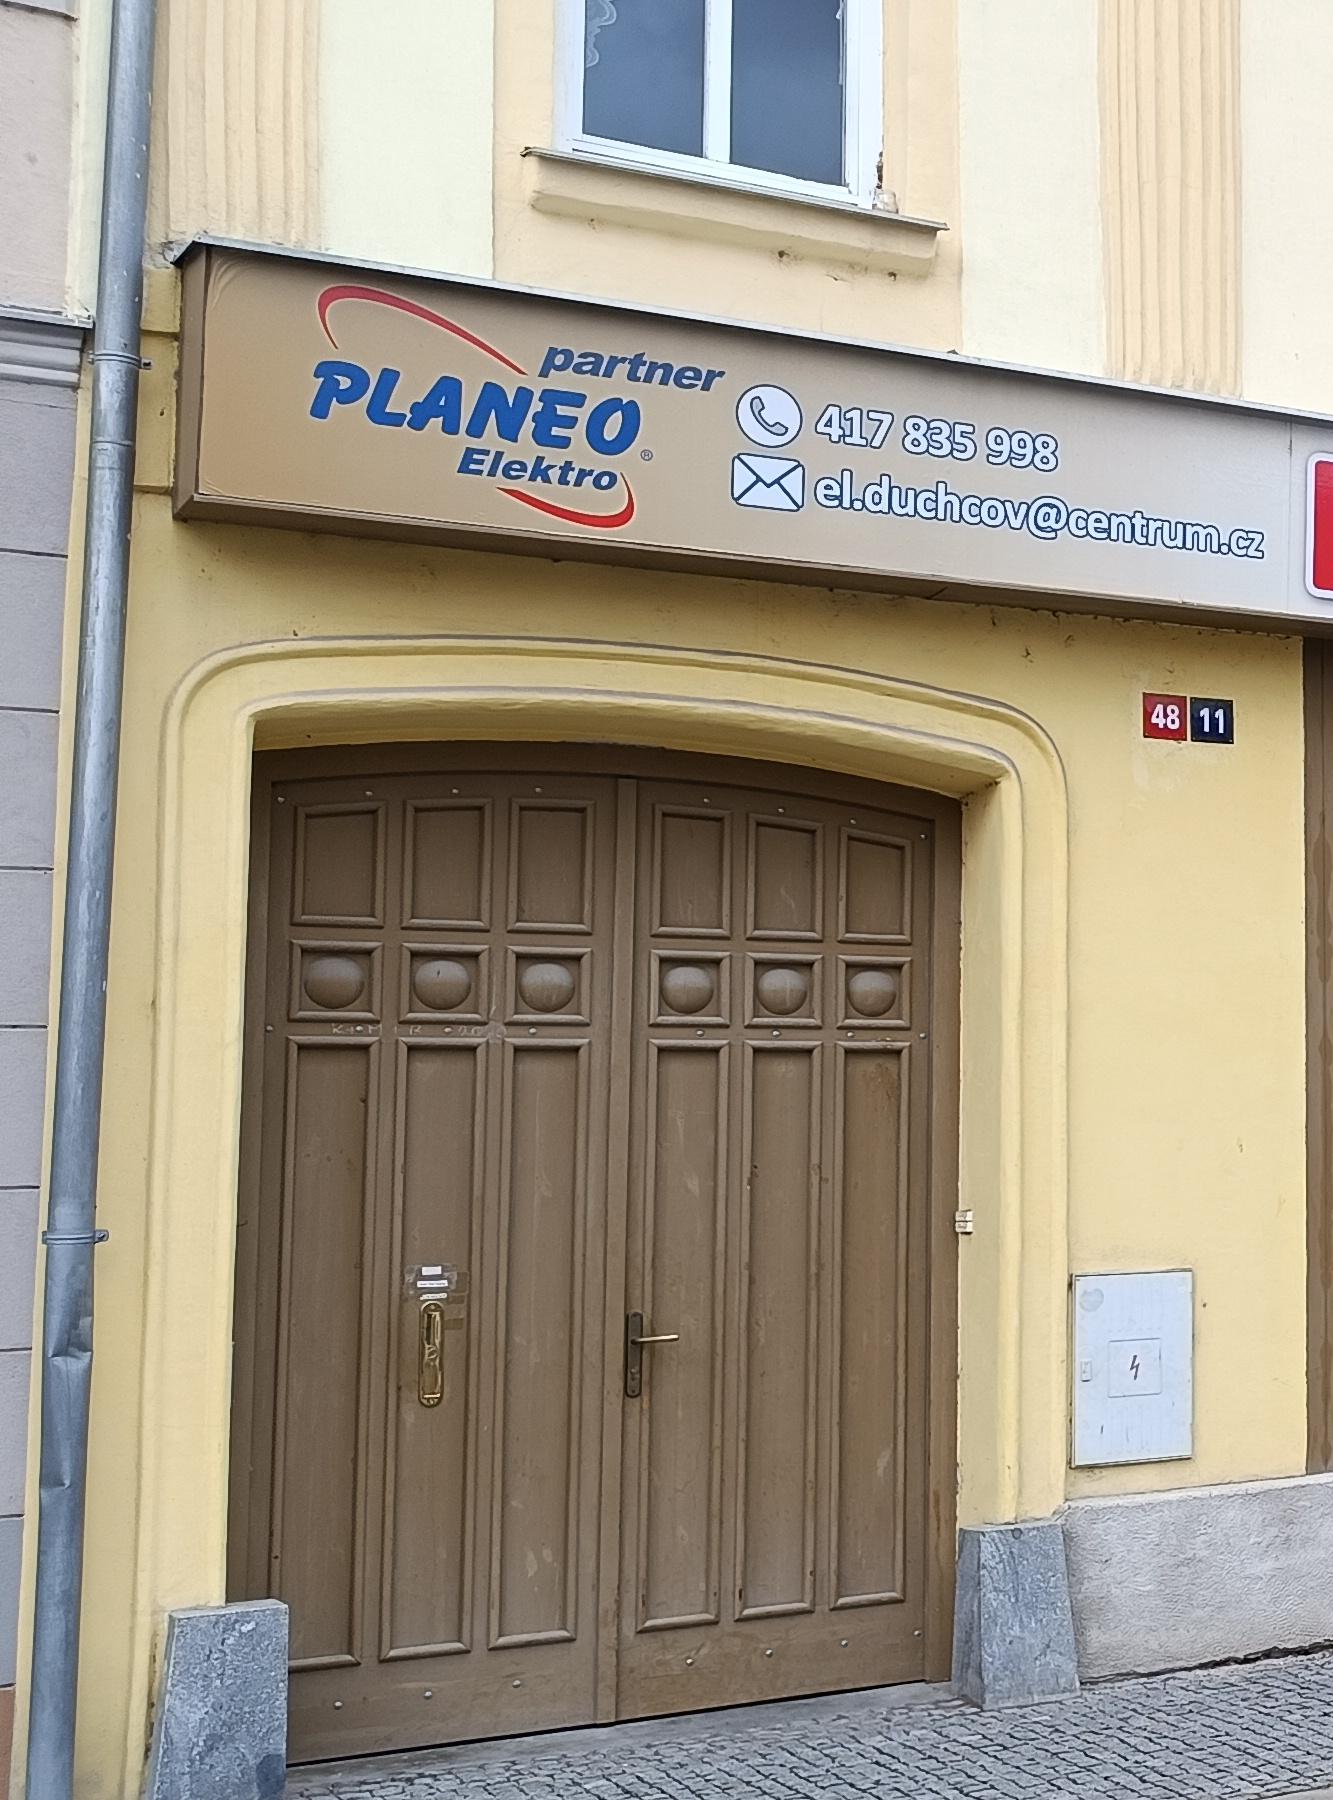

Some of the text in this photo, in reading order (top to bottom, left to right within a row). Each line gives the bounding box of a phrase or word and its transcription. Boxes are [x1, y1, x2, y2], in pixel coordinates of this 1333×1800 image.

[538, 346, 726, 392] partner
[309, 360, 641, 456] PLANEO
[815, 404, 1059, 472] 417 835 998
[457, 447, 618, 491] Elektro
[814, 469, 1265, 559] el.duchcov@centrum.cz
[1151, 703, 1224, 734] 48 11
